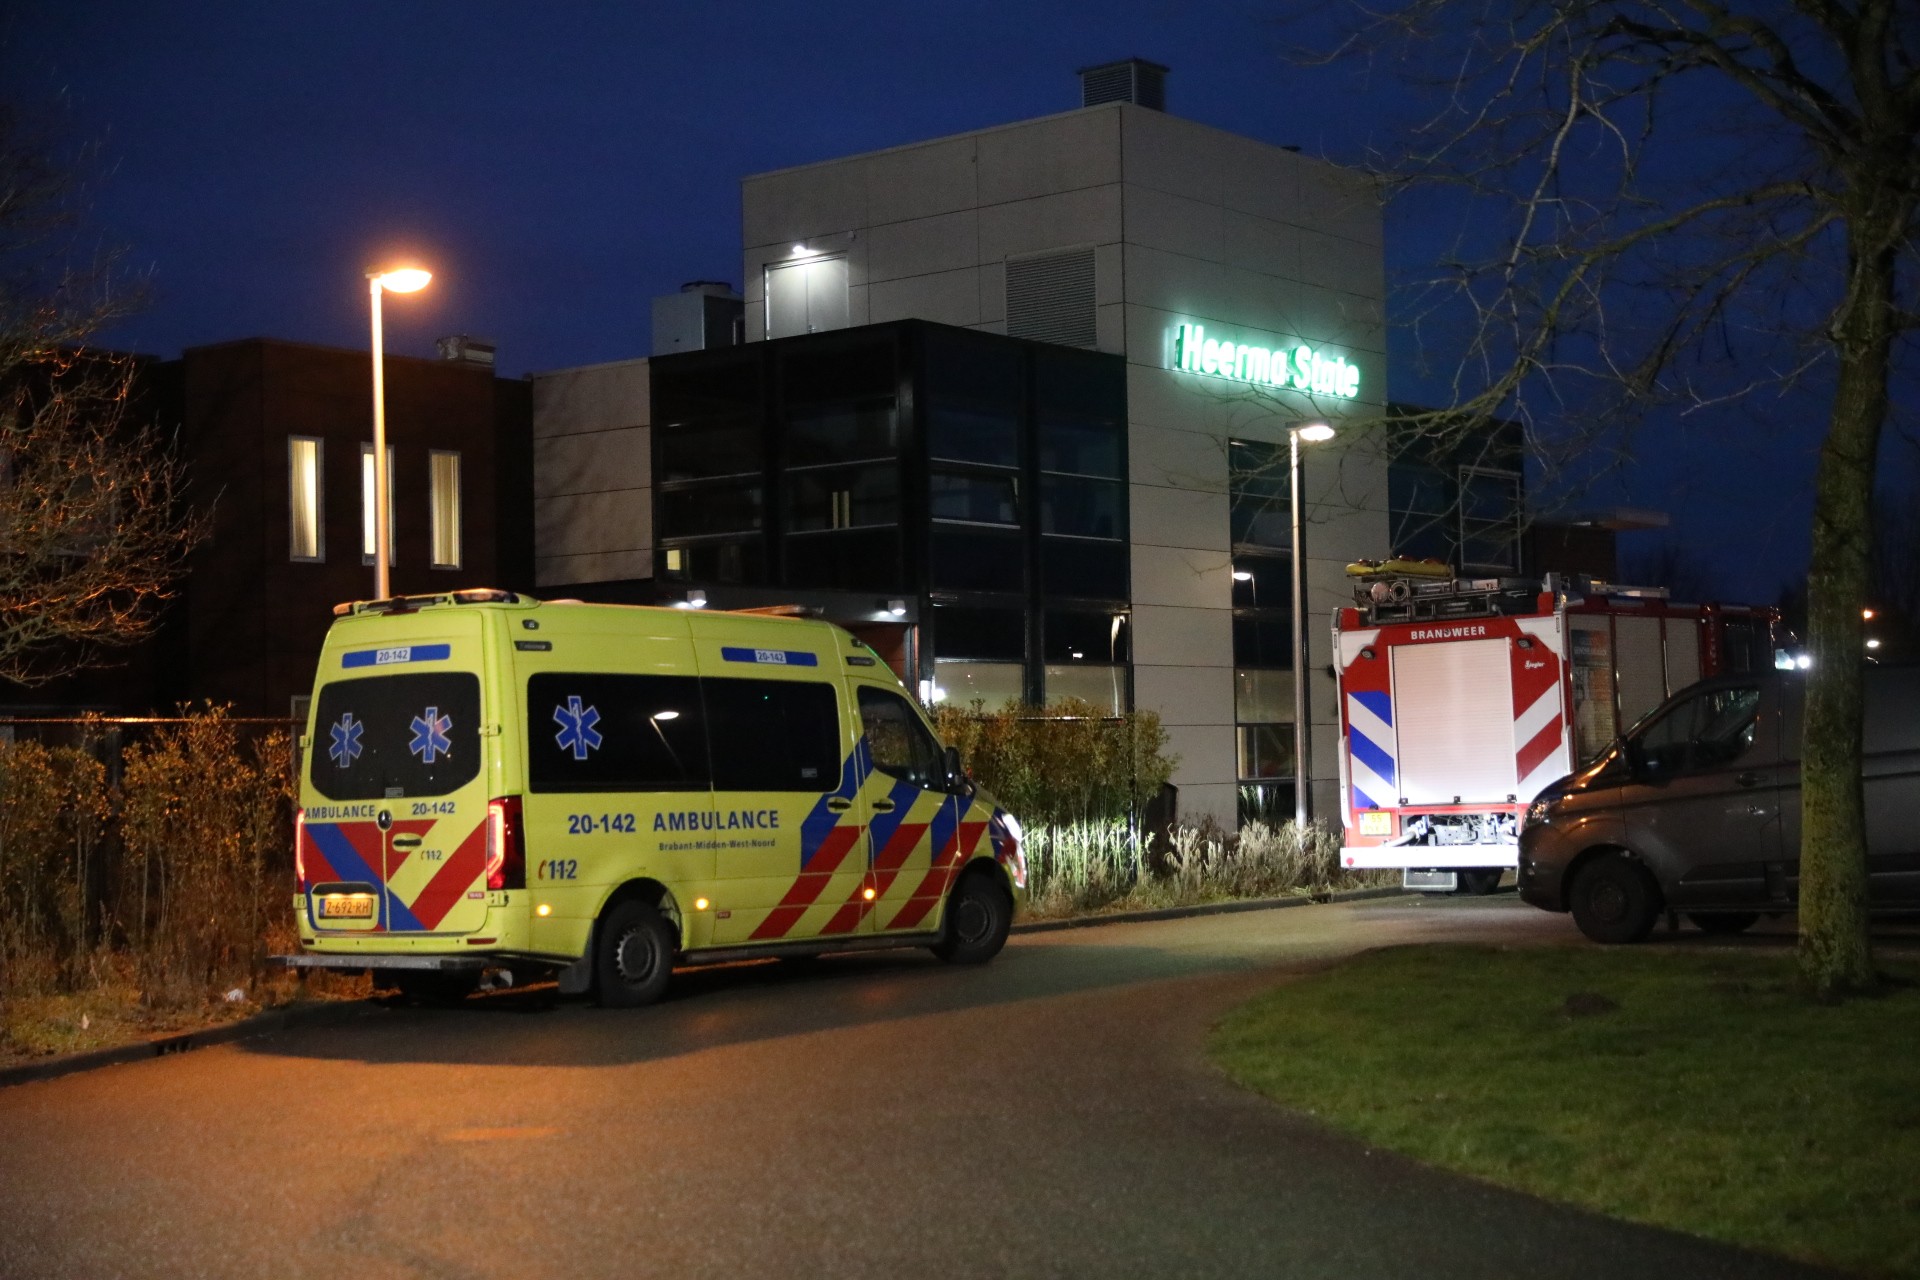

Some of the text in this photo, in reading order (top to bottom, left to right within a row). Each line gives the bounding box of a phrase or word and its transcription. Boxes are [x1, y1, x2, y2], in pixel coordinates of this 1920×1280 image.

[1176, 323, 1361, 399] Heerma State
[1410, 625, 1486, 640] BRANDWEER
[379, 649, 409, 661] 20-142
[757, 651, 785, 662] 20-142
[305, 804, 376, 819] AMBULANCE
[412, 802, 456, 816] 20-142
[568, 810, 780, 835] 20-142 AMBULANCE
[658, 838, 776, 851] Brabant-Midden-West-Noord
